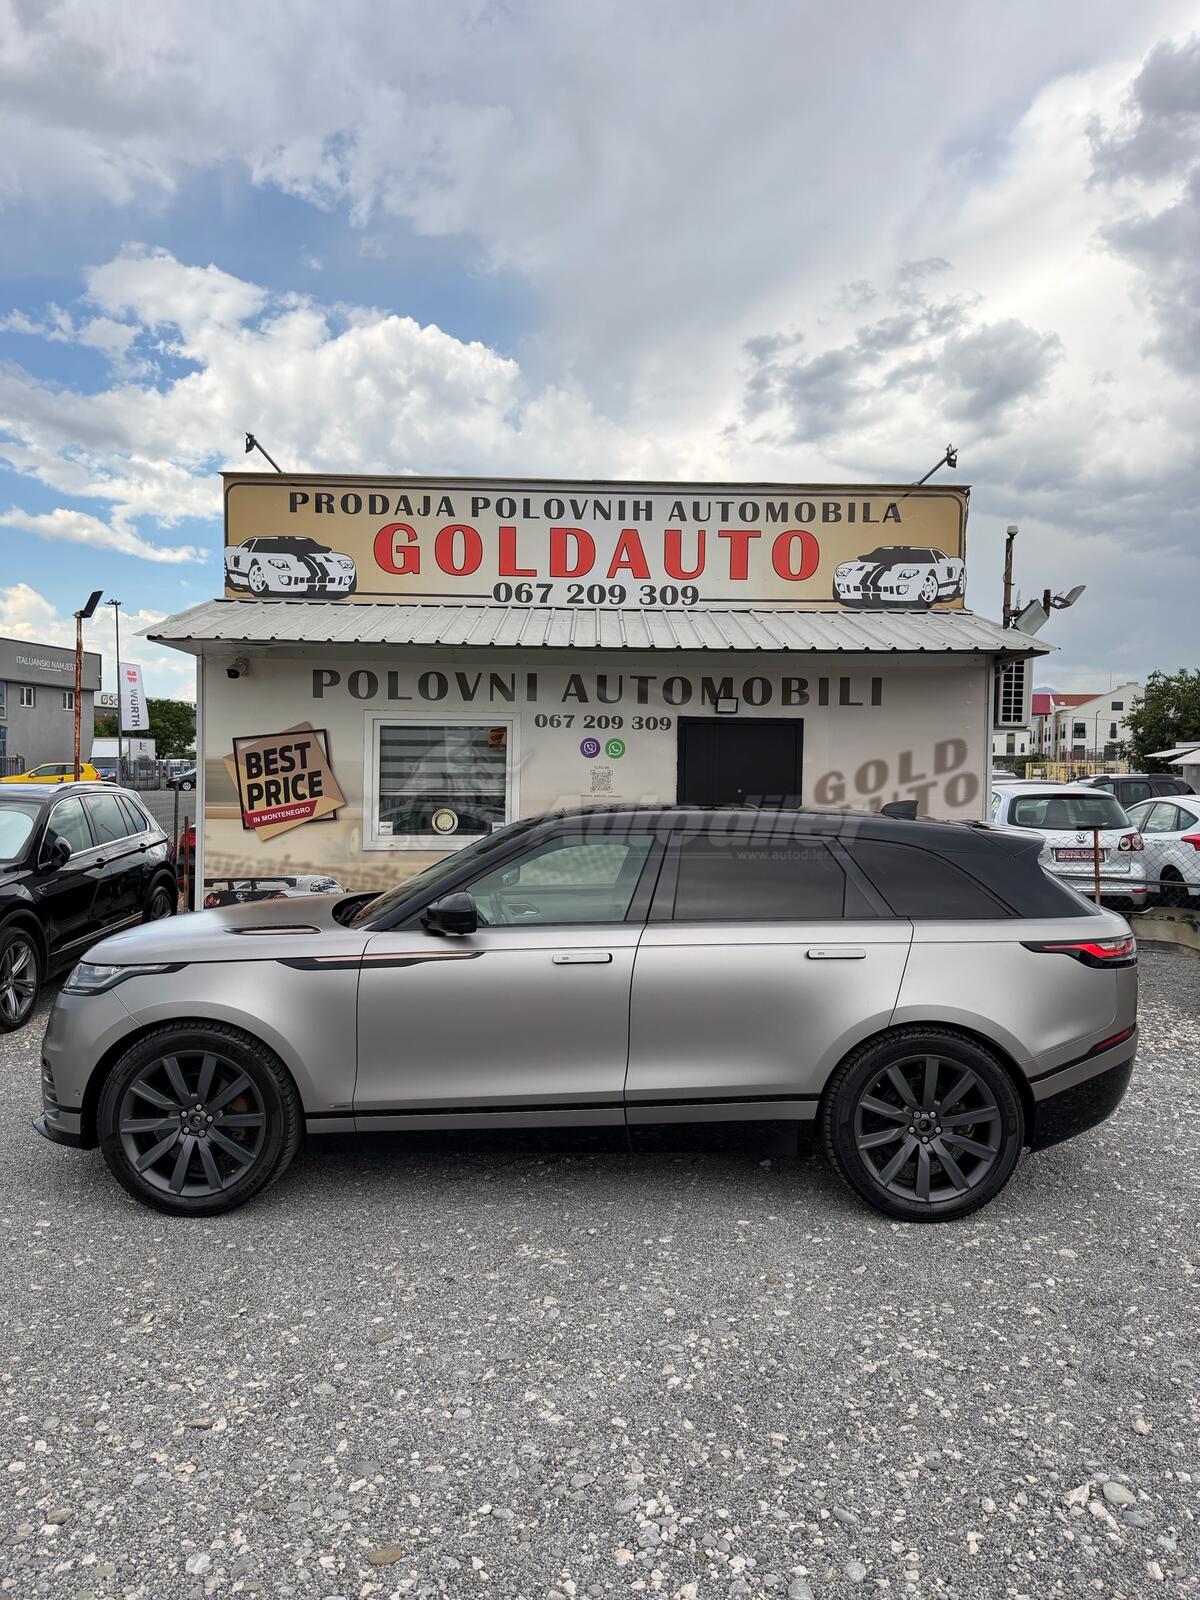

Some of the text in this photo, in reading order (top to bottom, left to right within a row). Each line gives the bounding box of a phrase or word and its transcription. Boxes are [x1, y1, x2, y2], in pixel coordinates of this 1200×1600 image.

[290, 492, 902, 523] PRODAJA POLOVNIH AUTOMOBILA
[373, 522, 820, 581] GOLDAUTO
[493, 583, 698, 606] 067 209 309
[312, 669, 882, 706] POLOVNI AUTOMOBILI
[534, 713, 672, 730] 067 209 309
[245, 741, 311, 779] BEST
[814, 738, 968, 804] GOLD
[247, 770, 323, 810] PRICE
[261, 806, 311, 821] MONTENEGRO
